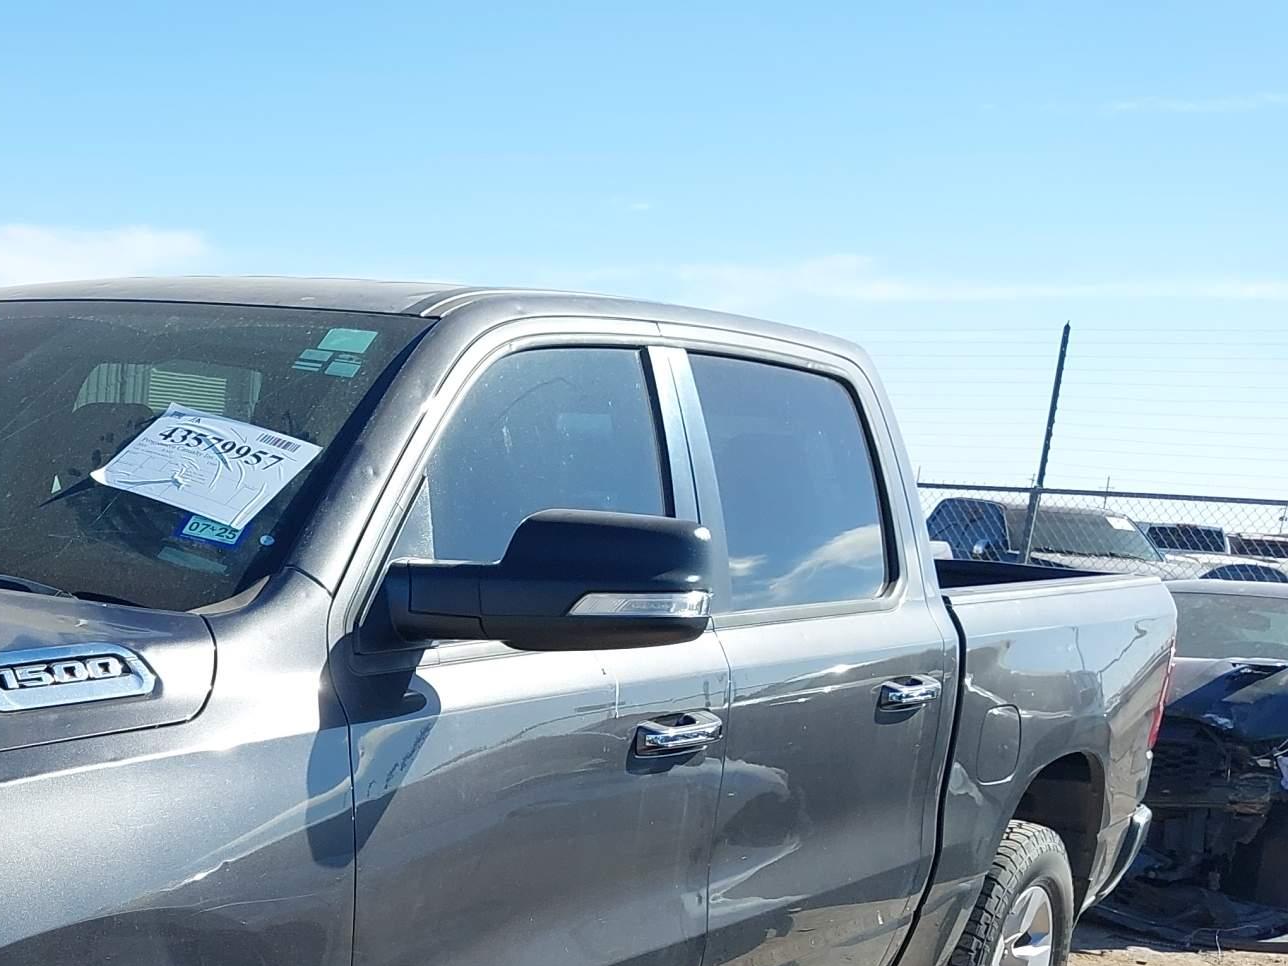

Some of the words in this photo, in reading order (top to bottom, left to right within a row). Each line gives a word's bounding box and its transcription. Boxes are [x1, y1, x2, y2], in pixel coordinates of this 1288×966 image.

[158, 426, 285, 471] 43579957
[188, 521, 211, 533] 07
[215, 526, 240, 540] 25
